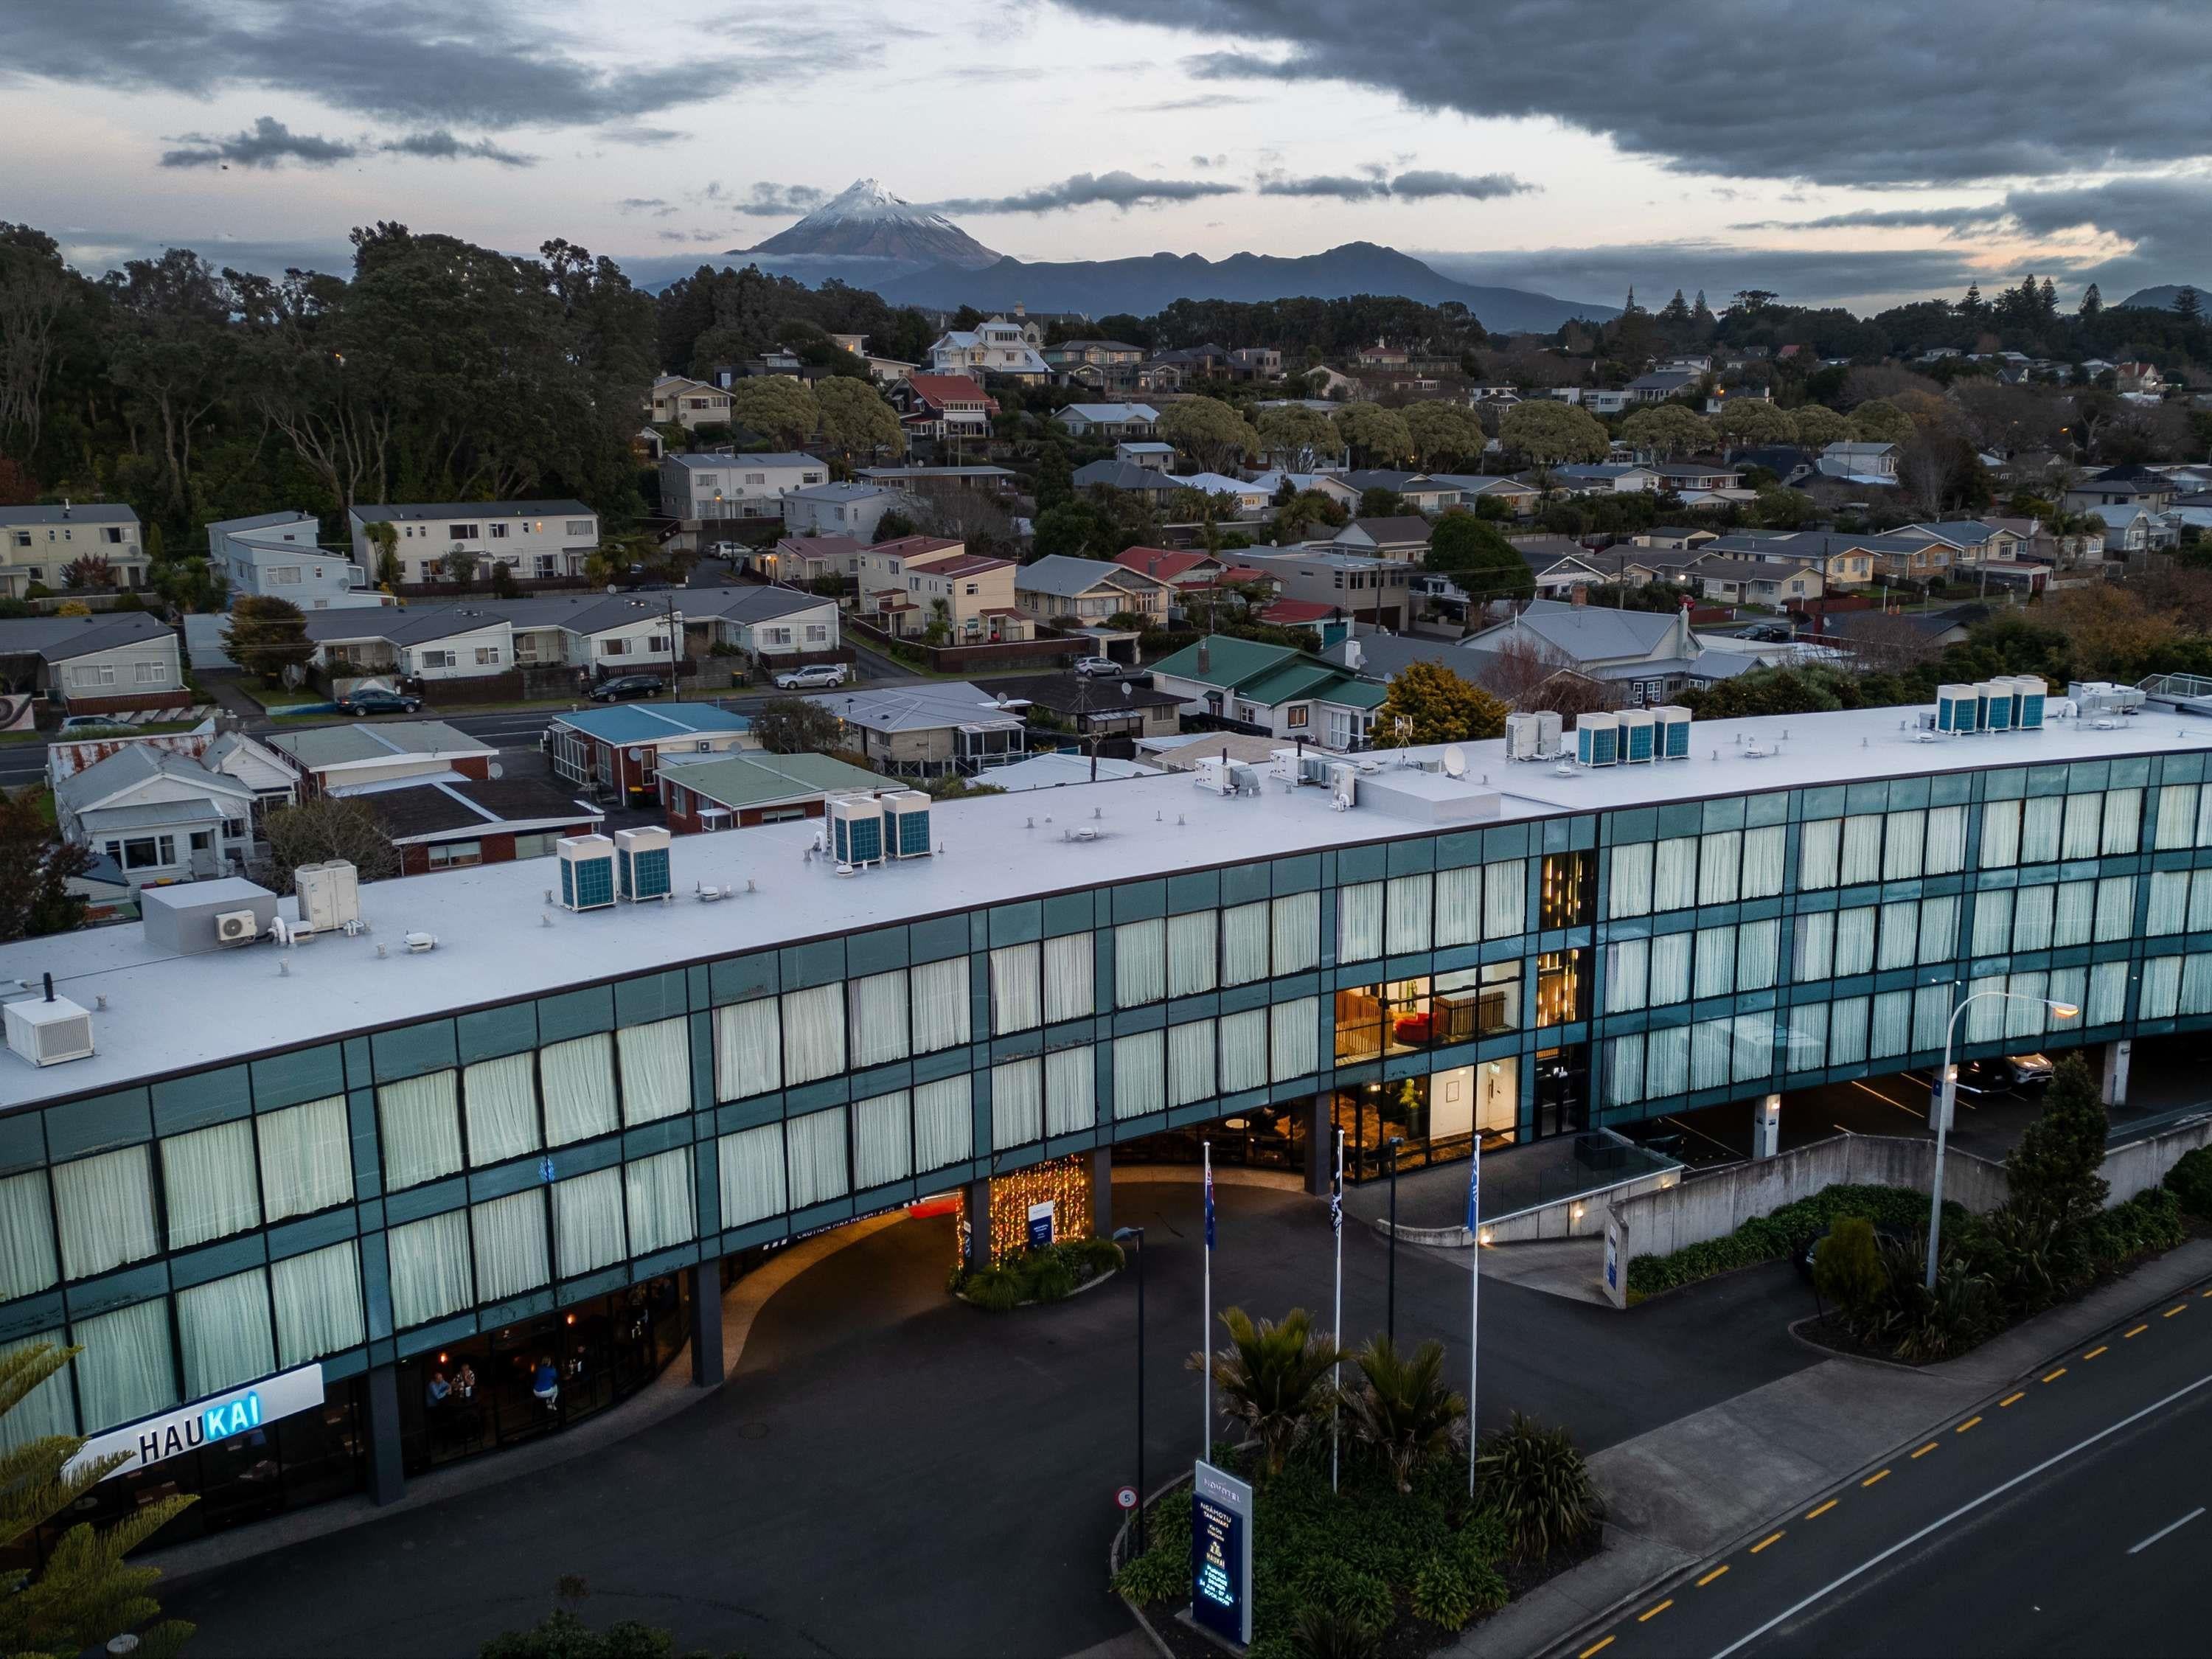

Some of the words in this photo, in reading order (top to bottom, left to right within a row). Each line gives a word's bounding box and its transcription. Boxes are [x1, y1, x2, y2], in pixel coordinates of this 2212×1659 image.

[138, 1394, 259, 1465] HAUKAI
[1124, 1494, 1130, 1503] 5
[1203, 1477, 1240, 1502] NOVOTEL
